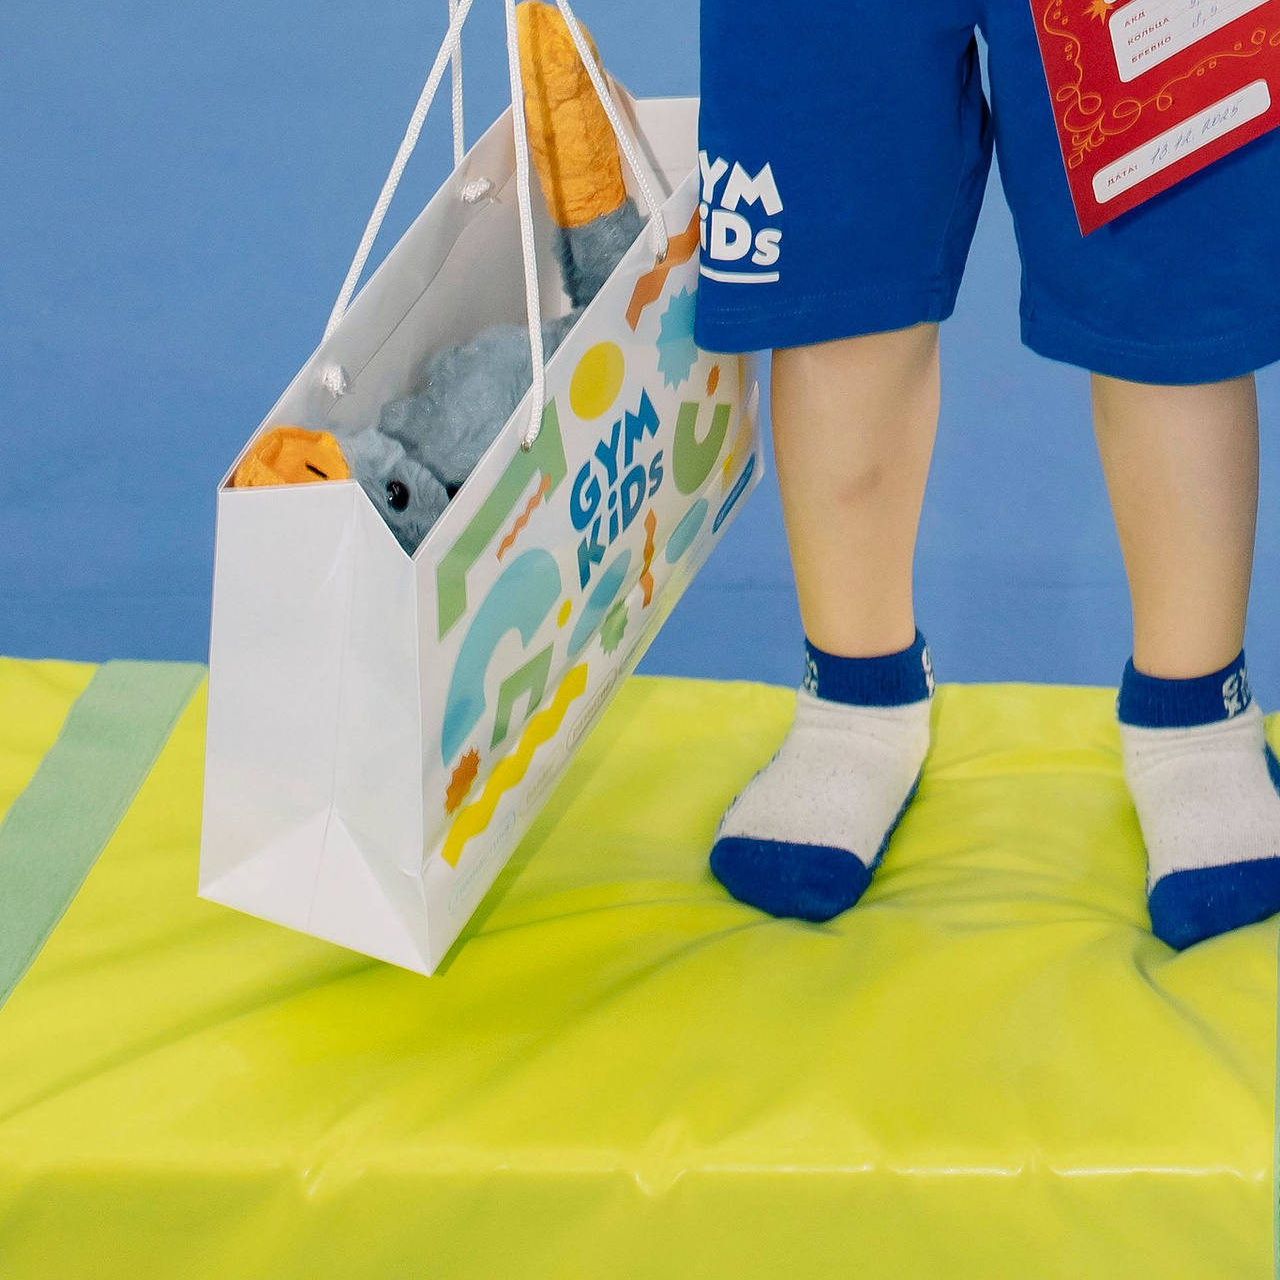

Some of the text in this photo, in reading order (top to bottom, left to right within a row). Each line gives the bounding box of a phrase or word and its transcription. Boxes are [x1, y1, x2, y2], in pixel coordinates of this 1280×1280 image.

[1124, 10, 1146, 28] АКД
[1127, 16, 1170, 46] КОЛЬЦА
[1131, 35, 1172, 64] БРЕВНО
[698, 149, 784, 216] YM
[1106, 163, 1139, 188] ДАТА:
[699, 201, 783, 267] iDs
[569, 386, 661, 533] GYM
